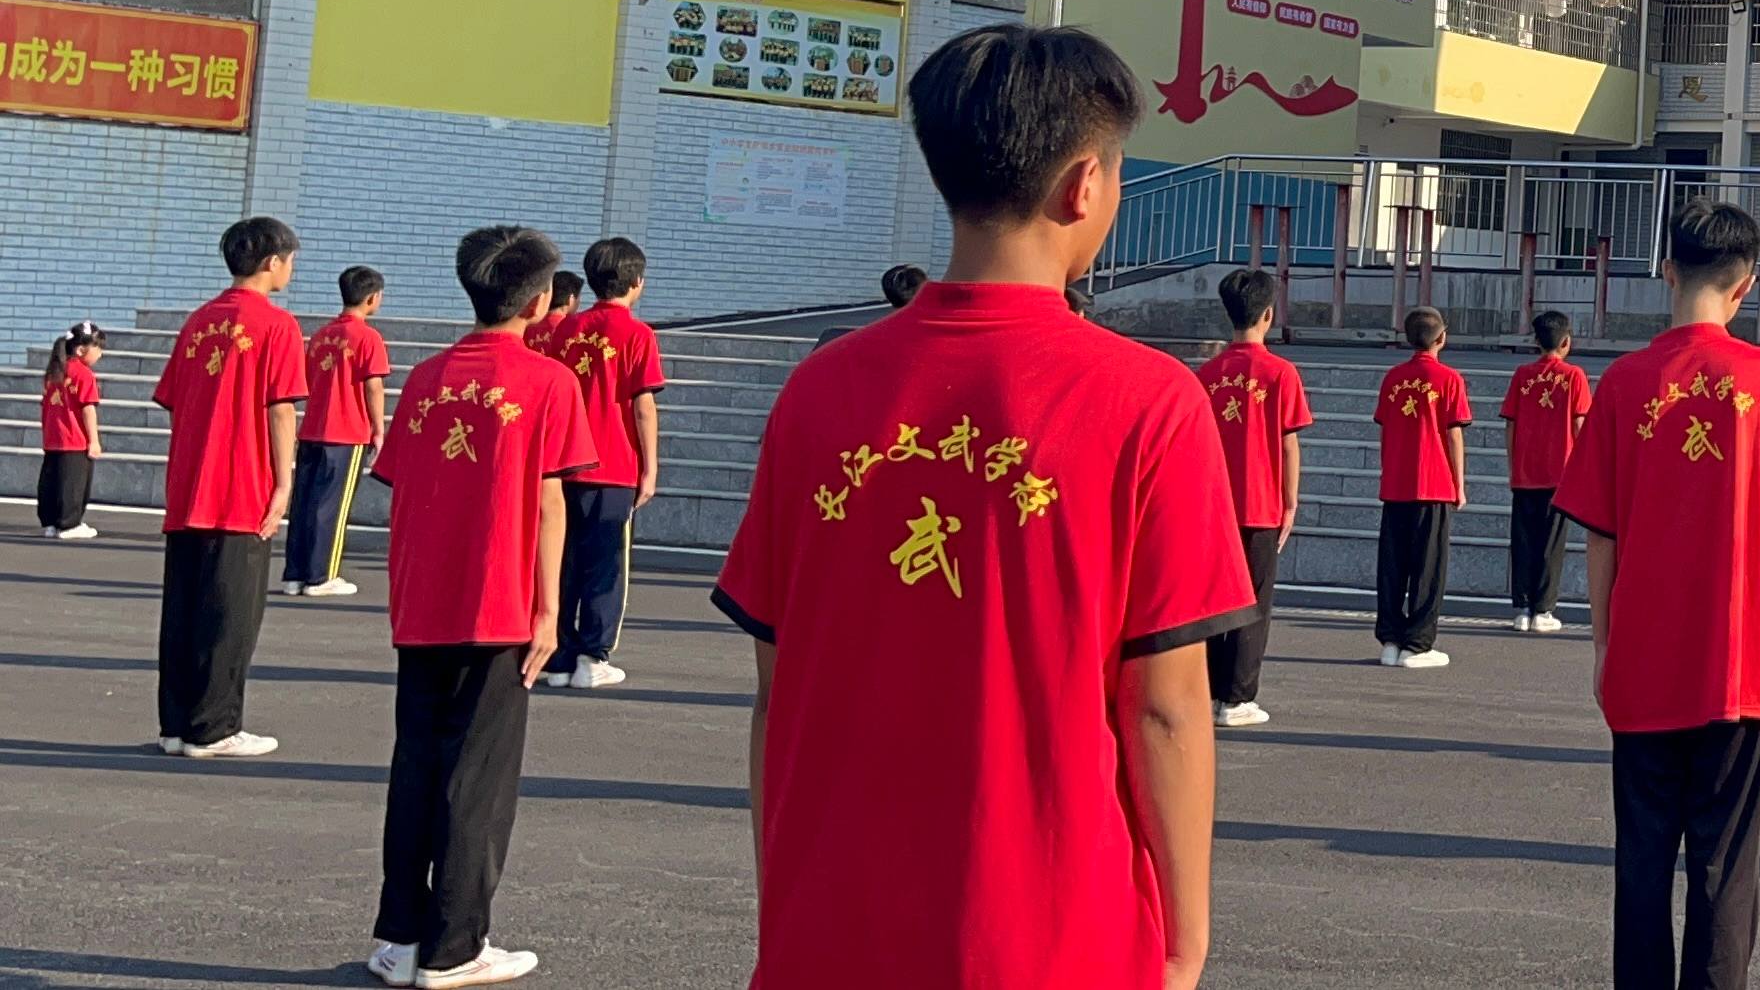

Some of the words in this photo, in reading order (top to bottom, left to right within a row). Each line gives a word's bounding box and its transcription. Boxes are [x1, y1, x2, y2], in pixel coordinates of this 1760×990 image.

[0, 36, 239, 100] 成为一种习惯
[1221, 395, 1244, 424] 武
[440, 417, 478, 464] 武
[1681, 414, 1725, 462] 武
[889, 495, 963, 599] 武
